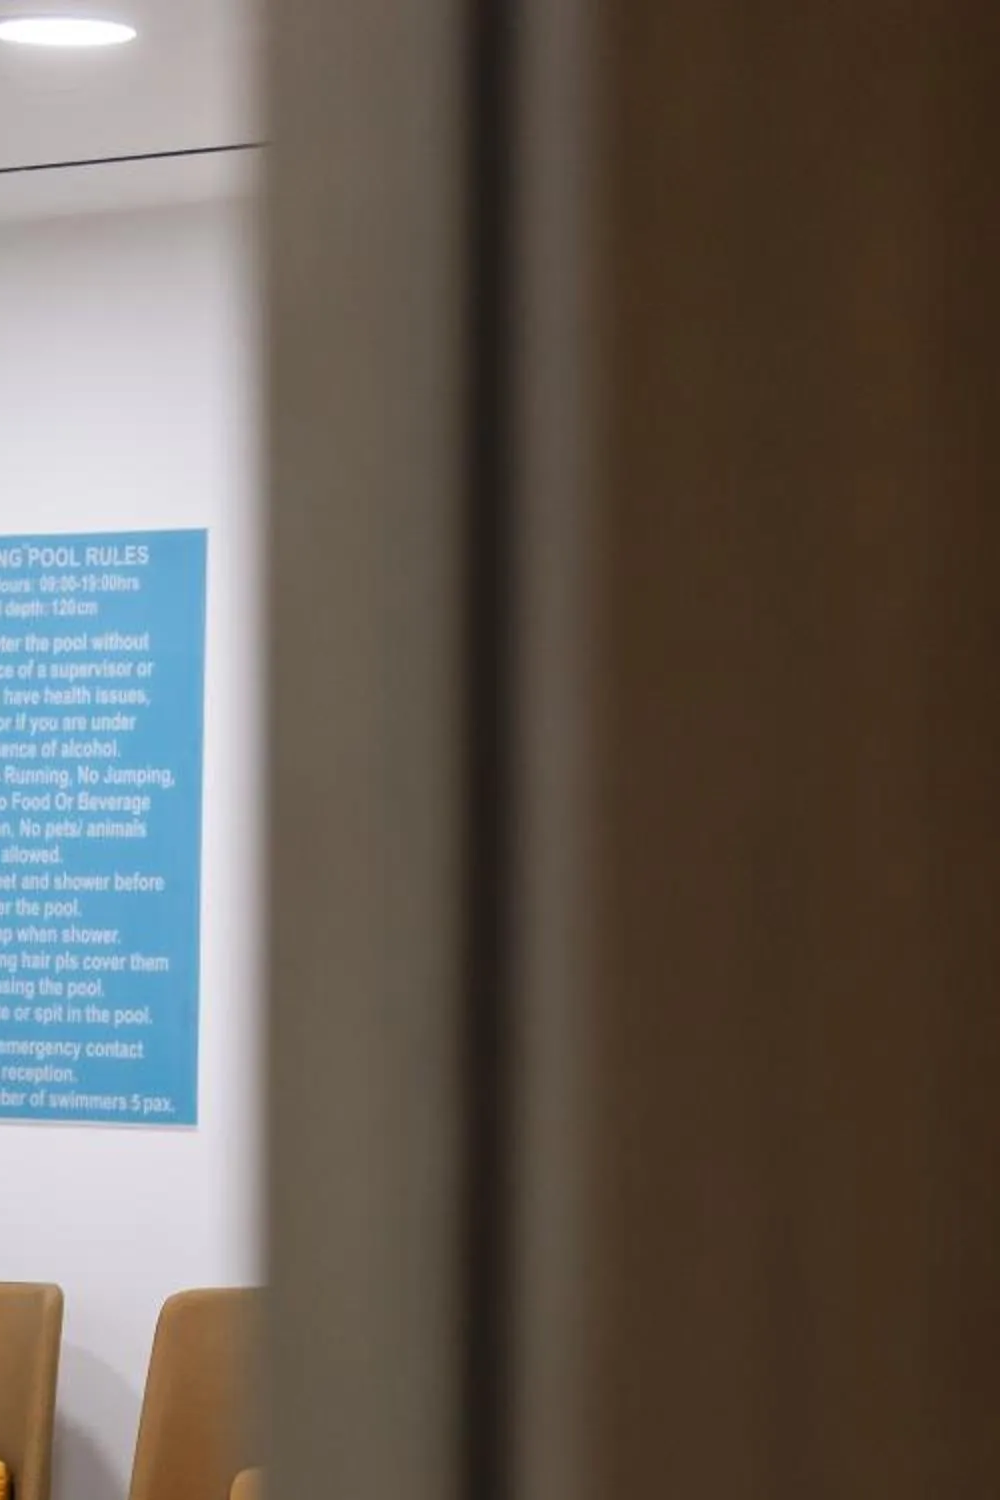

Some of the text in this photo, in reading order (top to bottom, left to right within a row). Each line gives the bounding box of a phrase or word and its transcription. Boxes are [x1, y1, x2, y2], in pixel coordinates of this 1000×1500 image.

[28, 546, 79, 568] POOL
[85, 545, 149, 566] RULES
[25, 632, 48, 652] the
[53, 632, 87, 655] pool
[92, 632, 149, 650] without
[18, 659, 34, 679] of
[37, 663, 46, 678] a
[51, 661, 133, 682] supervisor
[136, 661, 154, 677] or
[4, 687, 39, 705] have
[44, 686, 91, 704] health
[16, 712, 26, 731] if
[30, 717, 58, 735] you
[62, 715, 87, 731] are
[91, 712, 136, 731] under
[41, 740, 58, 758] of
[62, 739, 121, 758] alcohol.
[78, 766, 99, 784] No
[104, 765, 174, 789] Jumping,
[12, 792, 51, 811] Food
[55, 792, 74, 811] Or
[78, 793, 150, 815] Beverage
[20, 818, 41, 837] No
[86, 819, 147, 838] animals
[1, 844, 62, 864] allowed.
[21, 871, 48, 890] and
[53, 871, 110, 891] shower
[114, 872, 165, 891] before
[16, 899, 39, 917] the
[43, 900, 81, 921] pool.
[17, 925, 58, 943] when
[62, 926, 120, 944] shower.
[21, 951, 51, 969] hair
[55, 952, 77, 973] pls
[82, 955, 126, 970] cover
[130, 953, 169, 971] them
[39, 978, 62, 995] the
[67, 979, 104, 1000] pool.
[13, 1005, 31, 1021] or
[35, 1004, 63, 1025] spit
[68, 1005, 81, 1022] in
[86, 1005, 110, 1023] the
[114, 1006, 152, 1028] pool.
[86, 1040, 144, 1058] contact
[2, 1065, 77, 1083] reception.
[30, 1089, 45, 1107] of
[50, 1092, 126, 1110] swimmers
[131, 1094, 140, 1110] 5
[144, 1095, 175, 1113] pax.
